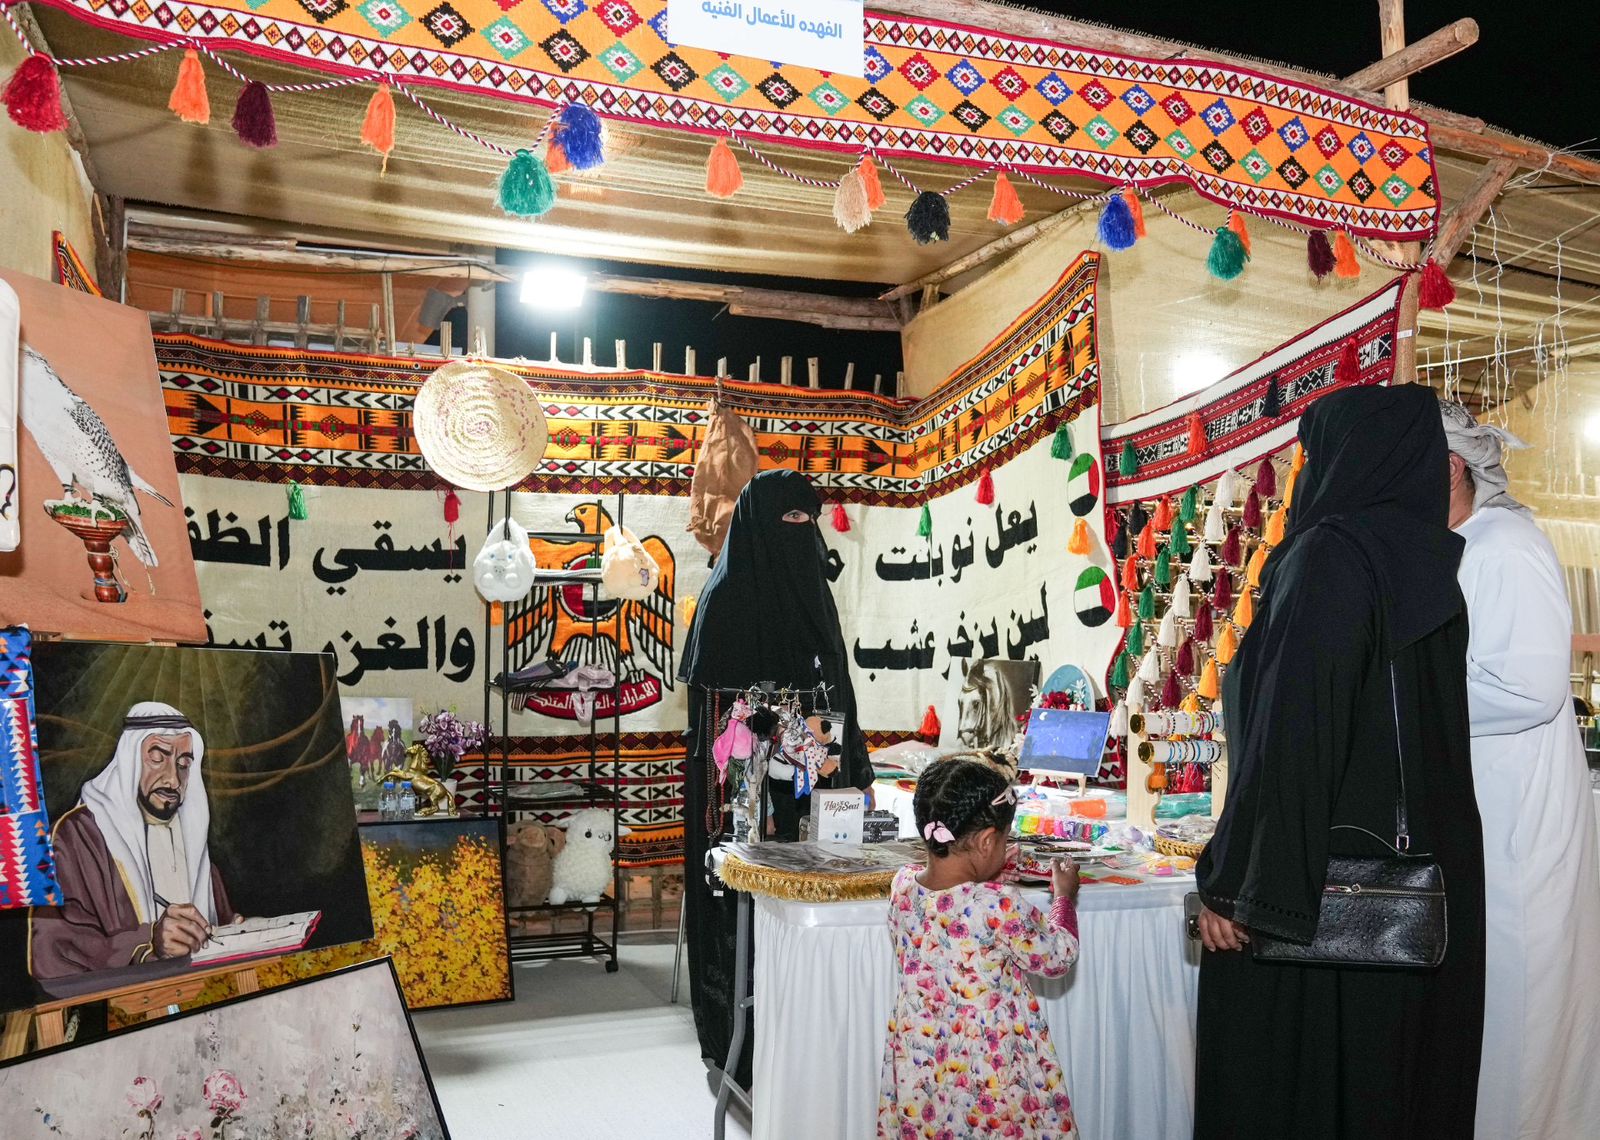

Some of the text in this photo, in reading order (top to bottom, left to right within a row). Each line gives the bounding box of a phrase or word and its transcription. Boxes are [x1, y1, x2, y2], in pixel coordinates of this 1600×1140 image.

[746, 6, 796, 29] للأعمال
[799, 20, 843, 39] الفهده
[312, 519, 466, 596] يسقي
[853, 618, 936, 683] عشب
